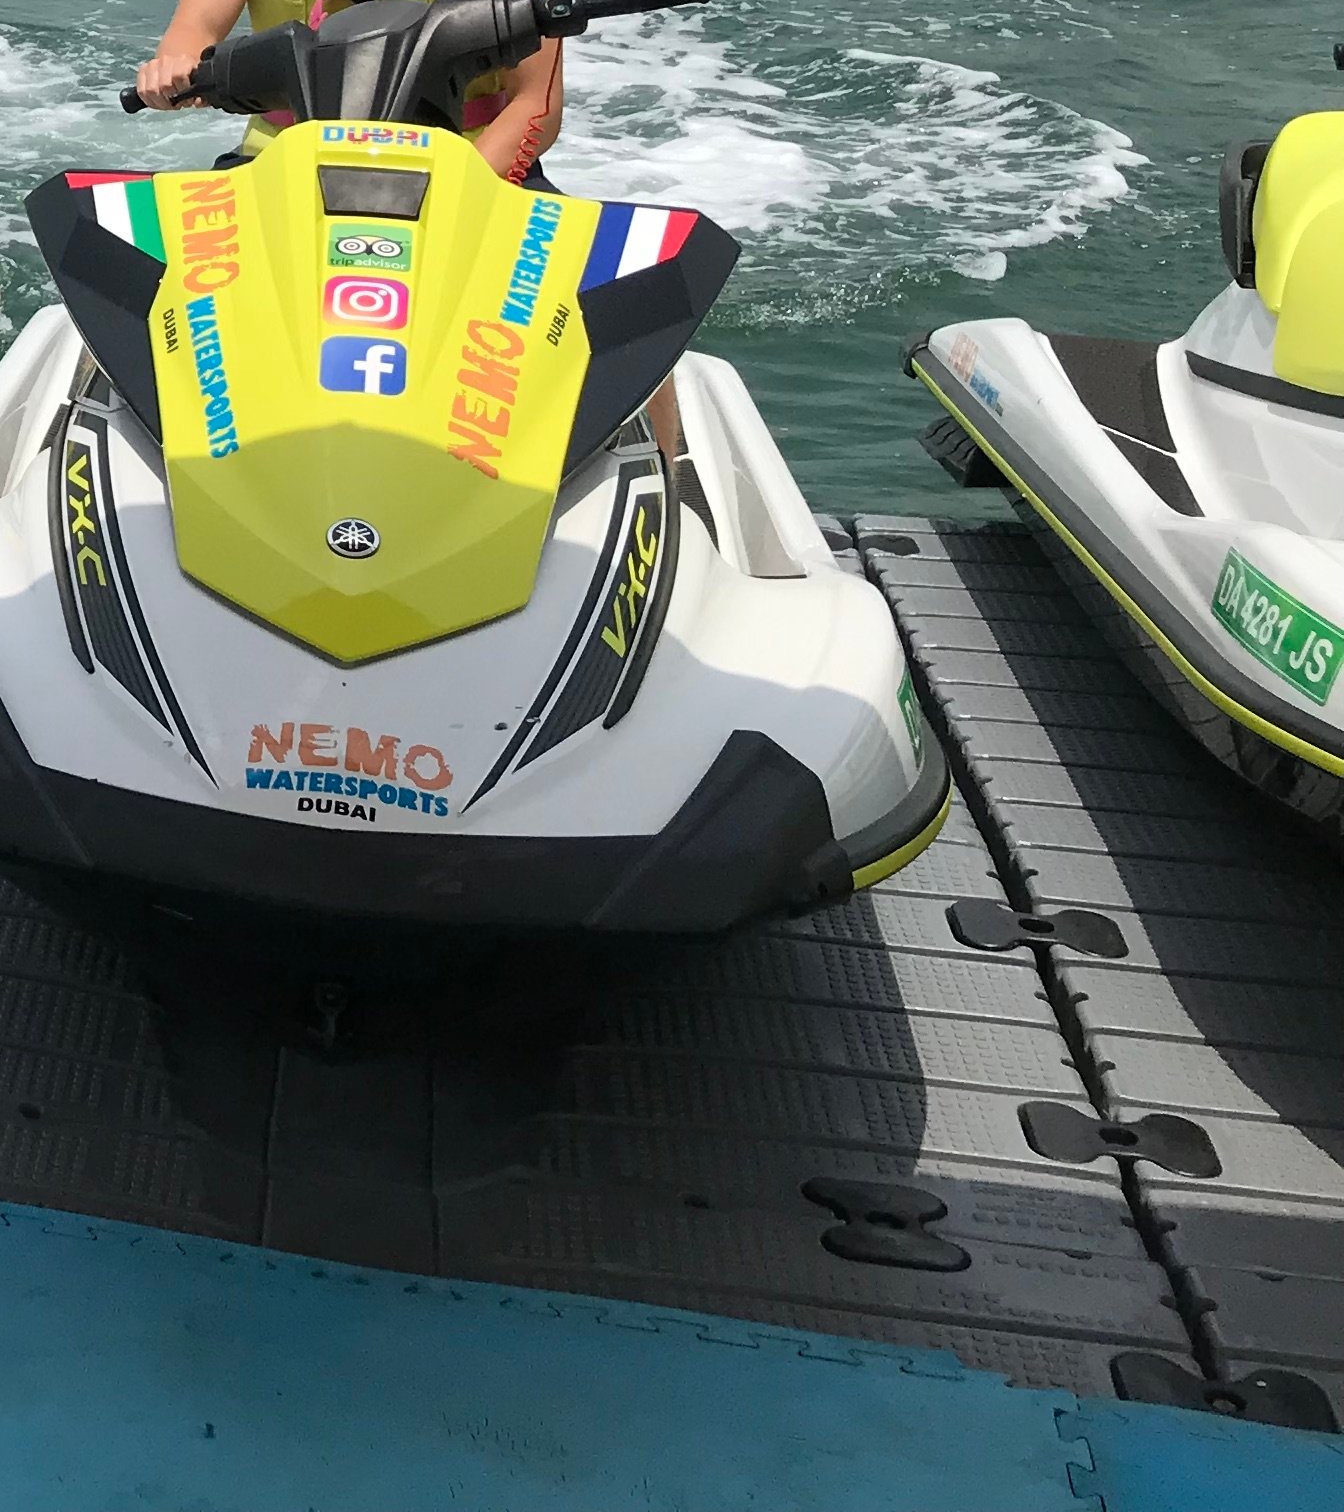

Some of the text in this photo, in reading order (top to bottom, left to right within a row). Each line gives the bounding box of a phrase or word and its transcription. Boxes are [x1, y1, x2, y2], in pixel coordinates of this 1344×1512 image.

[322, 125, 430, 148] DUBAI
[329, 256, 407, 271] tripadvisor
[162, 308, 179, 354] DUBAI
[180, 176, 240, 459] NEMO WATERSPORTS
[448, 197, 563, 480] NEMO WATERSPORTS
[545, 304, 571, 347] DUBAI
[68, 454, 107, 587] VX-C
[601, 506, 657, 658] VX-C
[1218, 564, 1334, 683] DA 4281 JS
[247, 721, 454, 791] NEMO
[245, 767, 449, 817] WATERSPORTS
[297, 797, 377, 822] DUBAI
